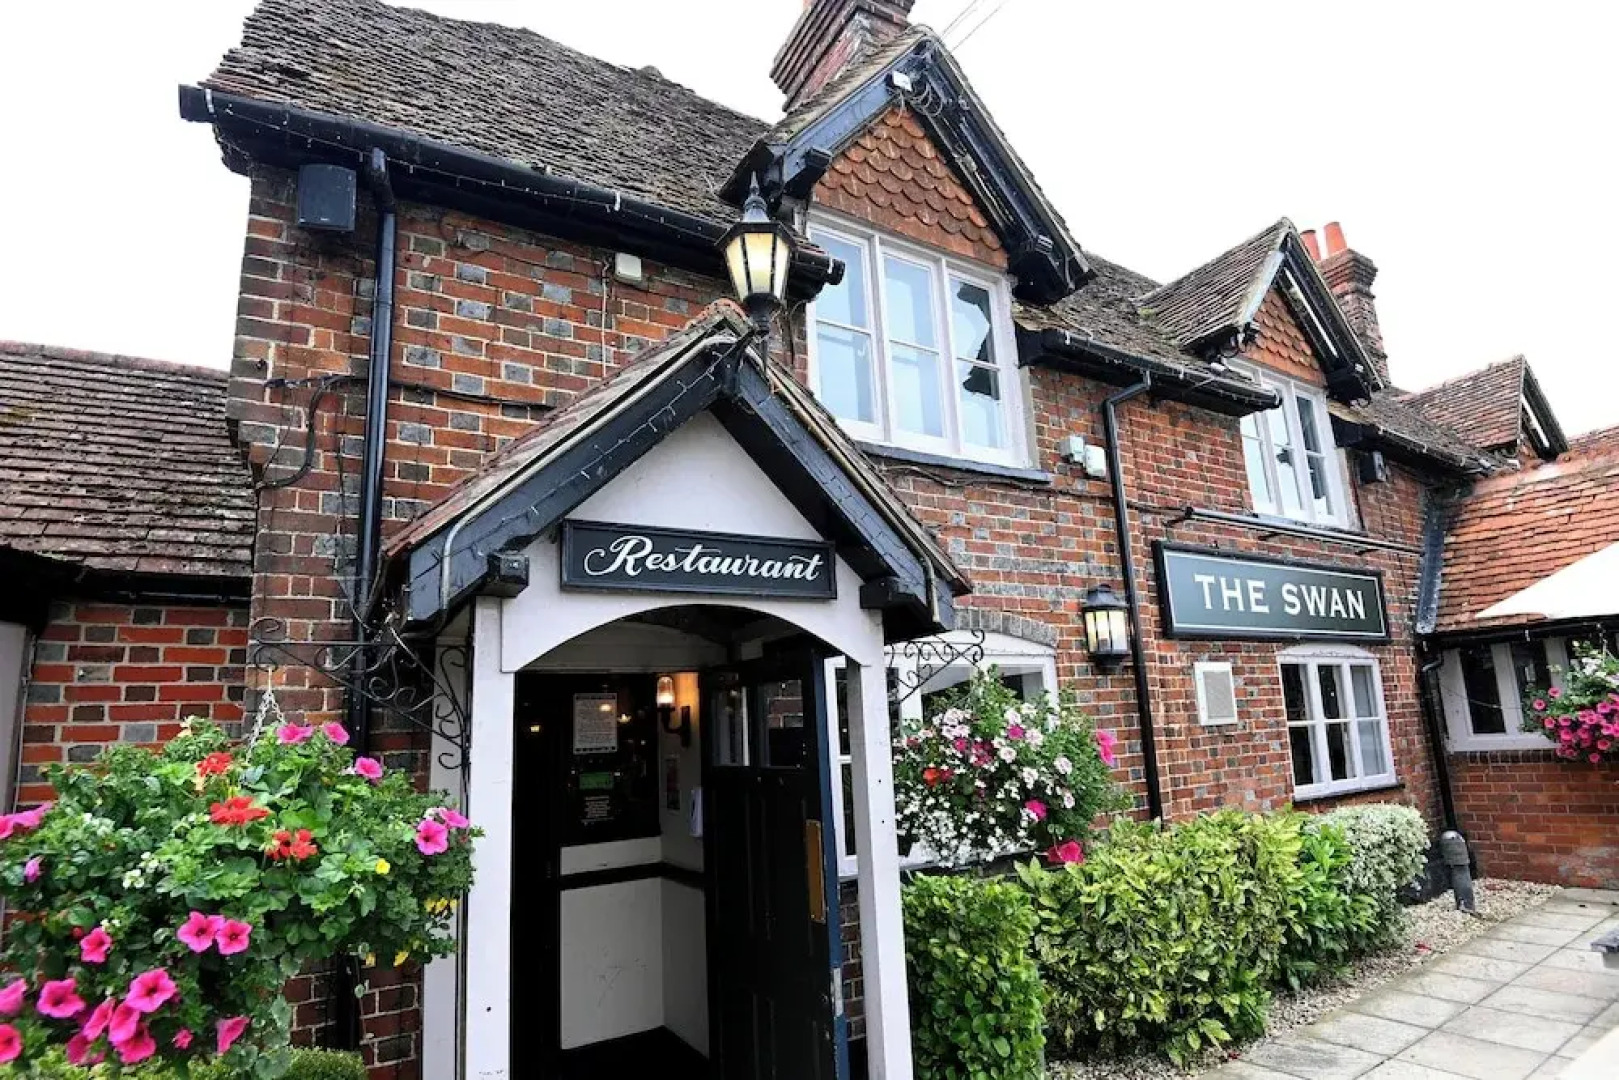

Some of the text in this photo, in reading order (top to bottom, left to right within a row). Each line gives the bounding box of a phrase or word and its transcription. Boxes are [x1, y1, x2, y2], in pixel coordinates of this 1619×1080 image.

[584, 535, 823, 580] Restaurant
[1194, 574, 1366, 619] THE SWAN
